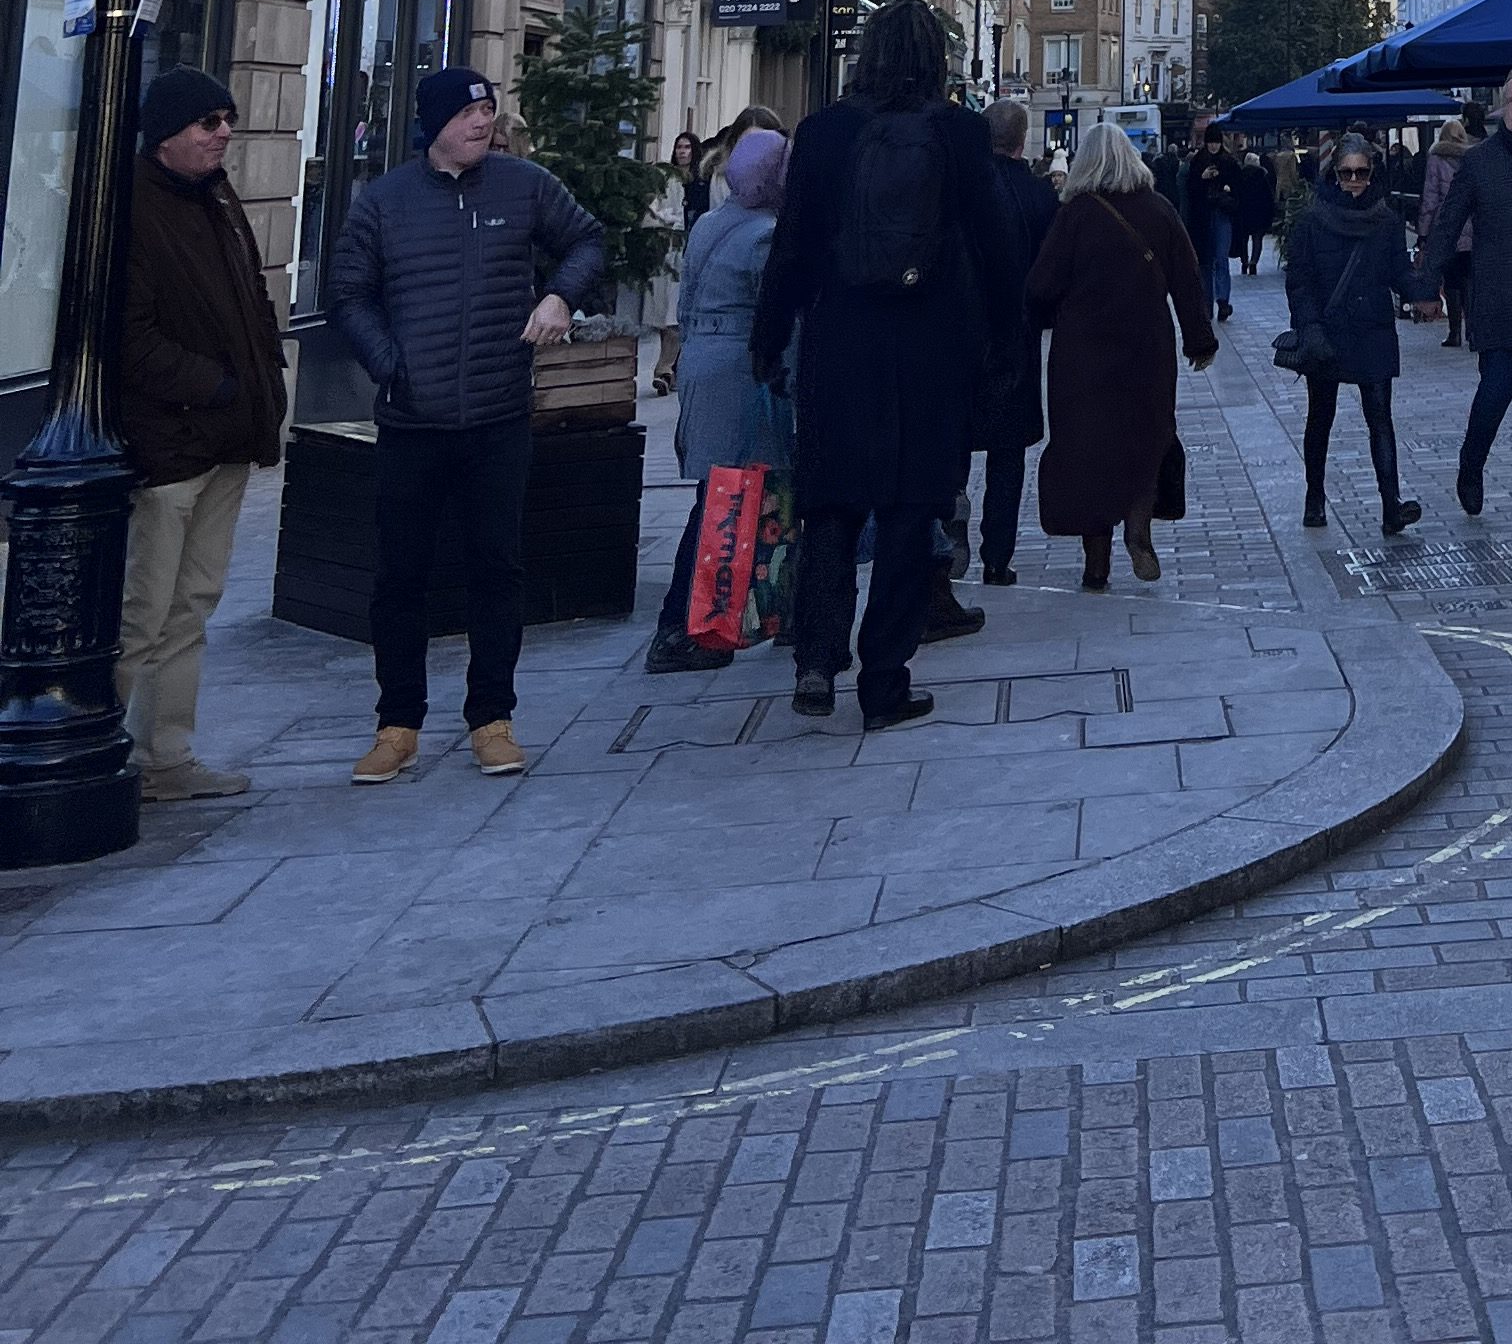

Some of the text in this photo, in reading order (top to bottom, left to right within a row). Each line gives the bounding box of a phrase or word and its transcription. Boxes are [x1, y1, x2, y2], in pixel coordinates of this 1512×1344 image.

[719, 2, 781, 13] 020 7224 2222
